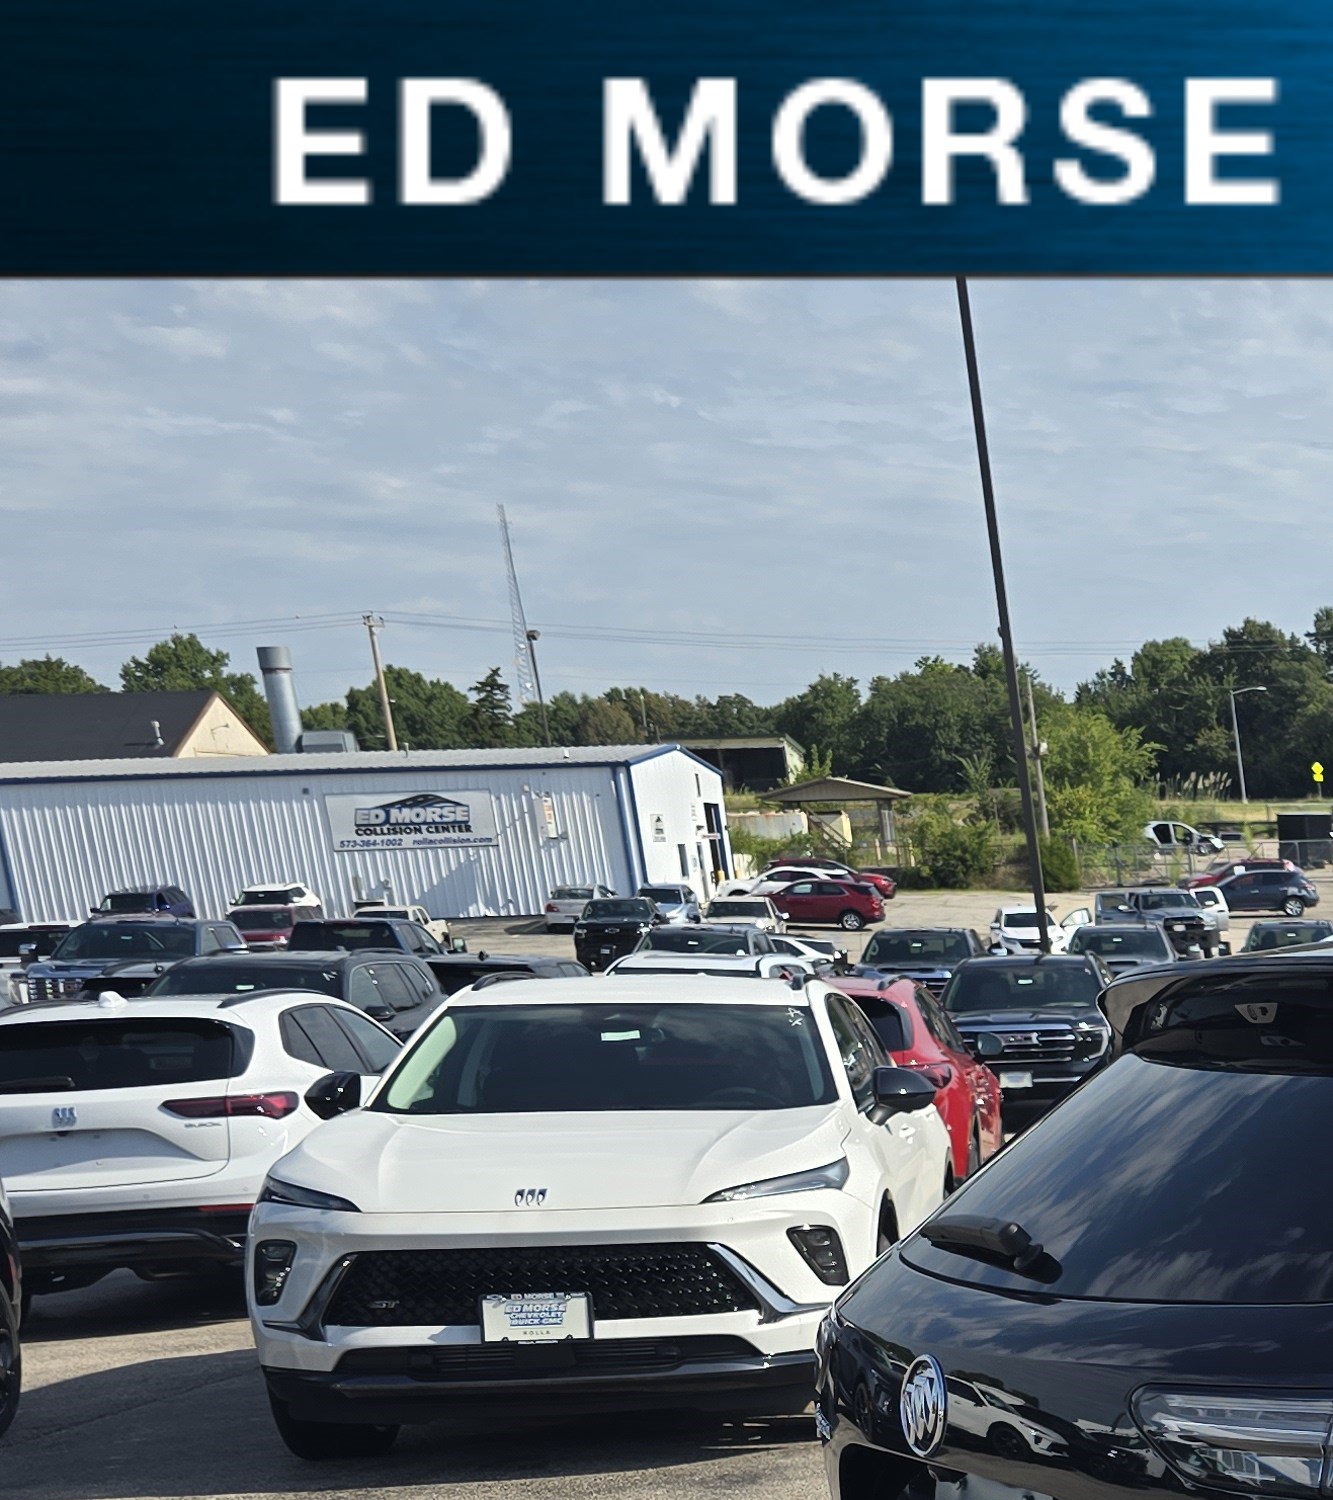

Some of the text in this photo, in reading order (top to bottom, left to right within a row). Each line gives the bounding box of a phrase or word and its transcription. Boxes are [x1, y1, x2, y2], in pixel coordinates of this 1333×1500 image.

[355, 805, 470, 826] ED MORSE
[355, 823, 473, 837] COLLISION CENTER
[340, 838, 404, 848] 573-364-1002
[522, 1303, 566, 1313] MORSE
